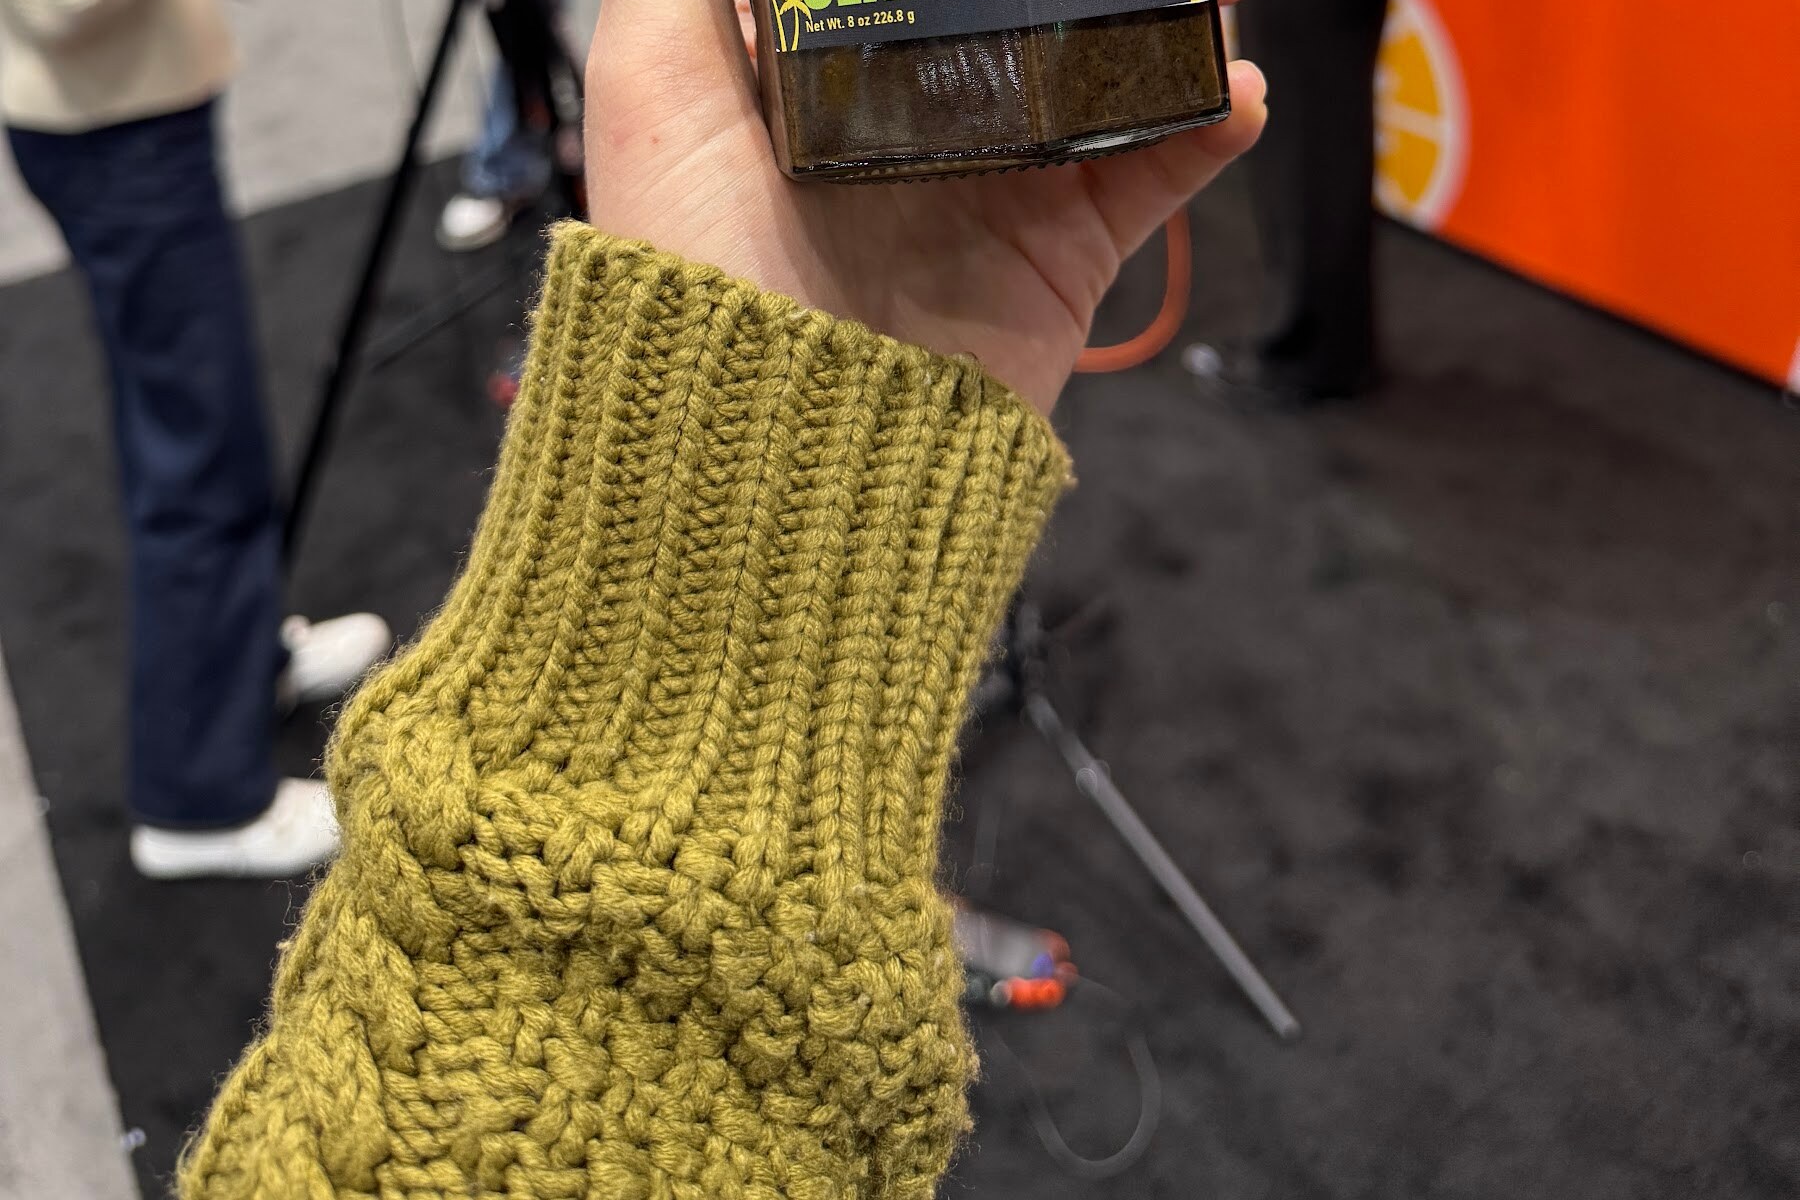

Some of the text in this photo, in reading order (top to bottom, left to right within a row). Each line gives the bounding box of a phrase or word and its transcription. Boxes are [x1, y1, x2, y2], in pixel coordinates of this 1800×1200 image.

[805, 9, 915, 33] Net Wt. 8 oz 226.8 g
